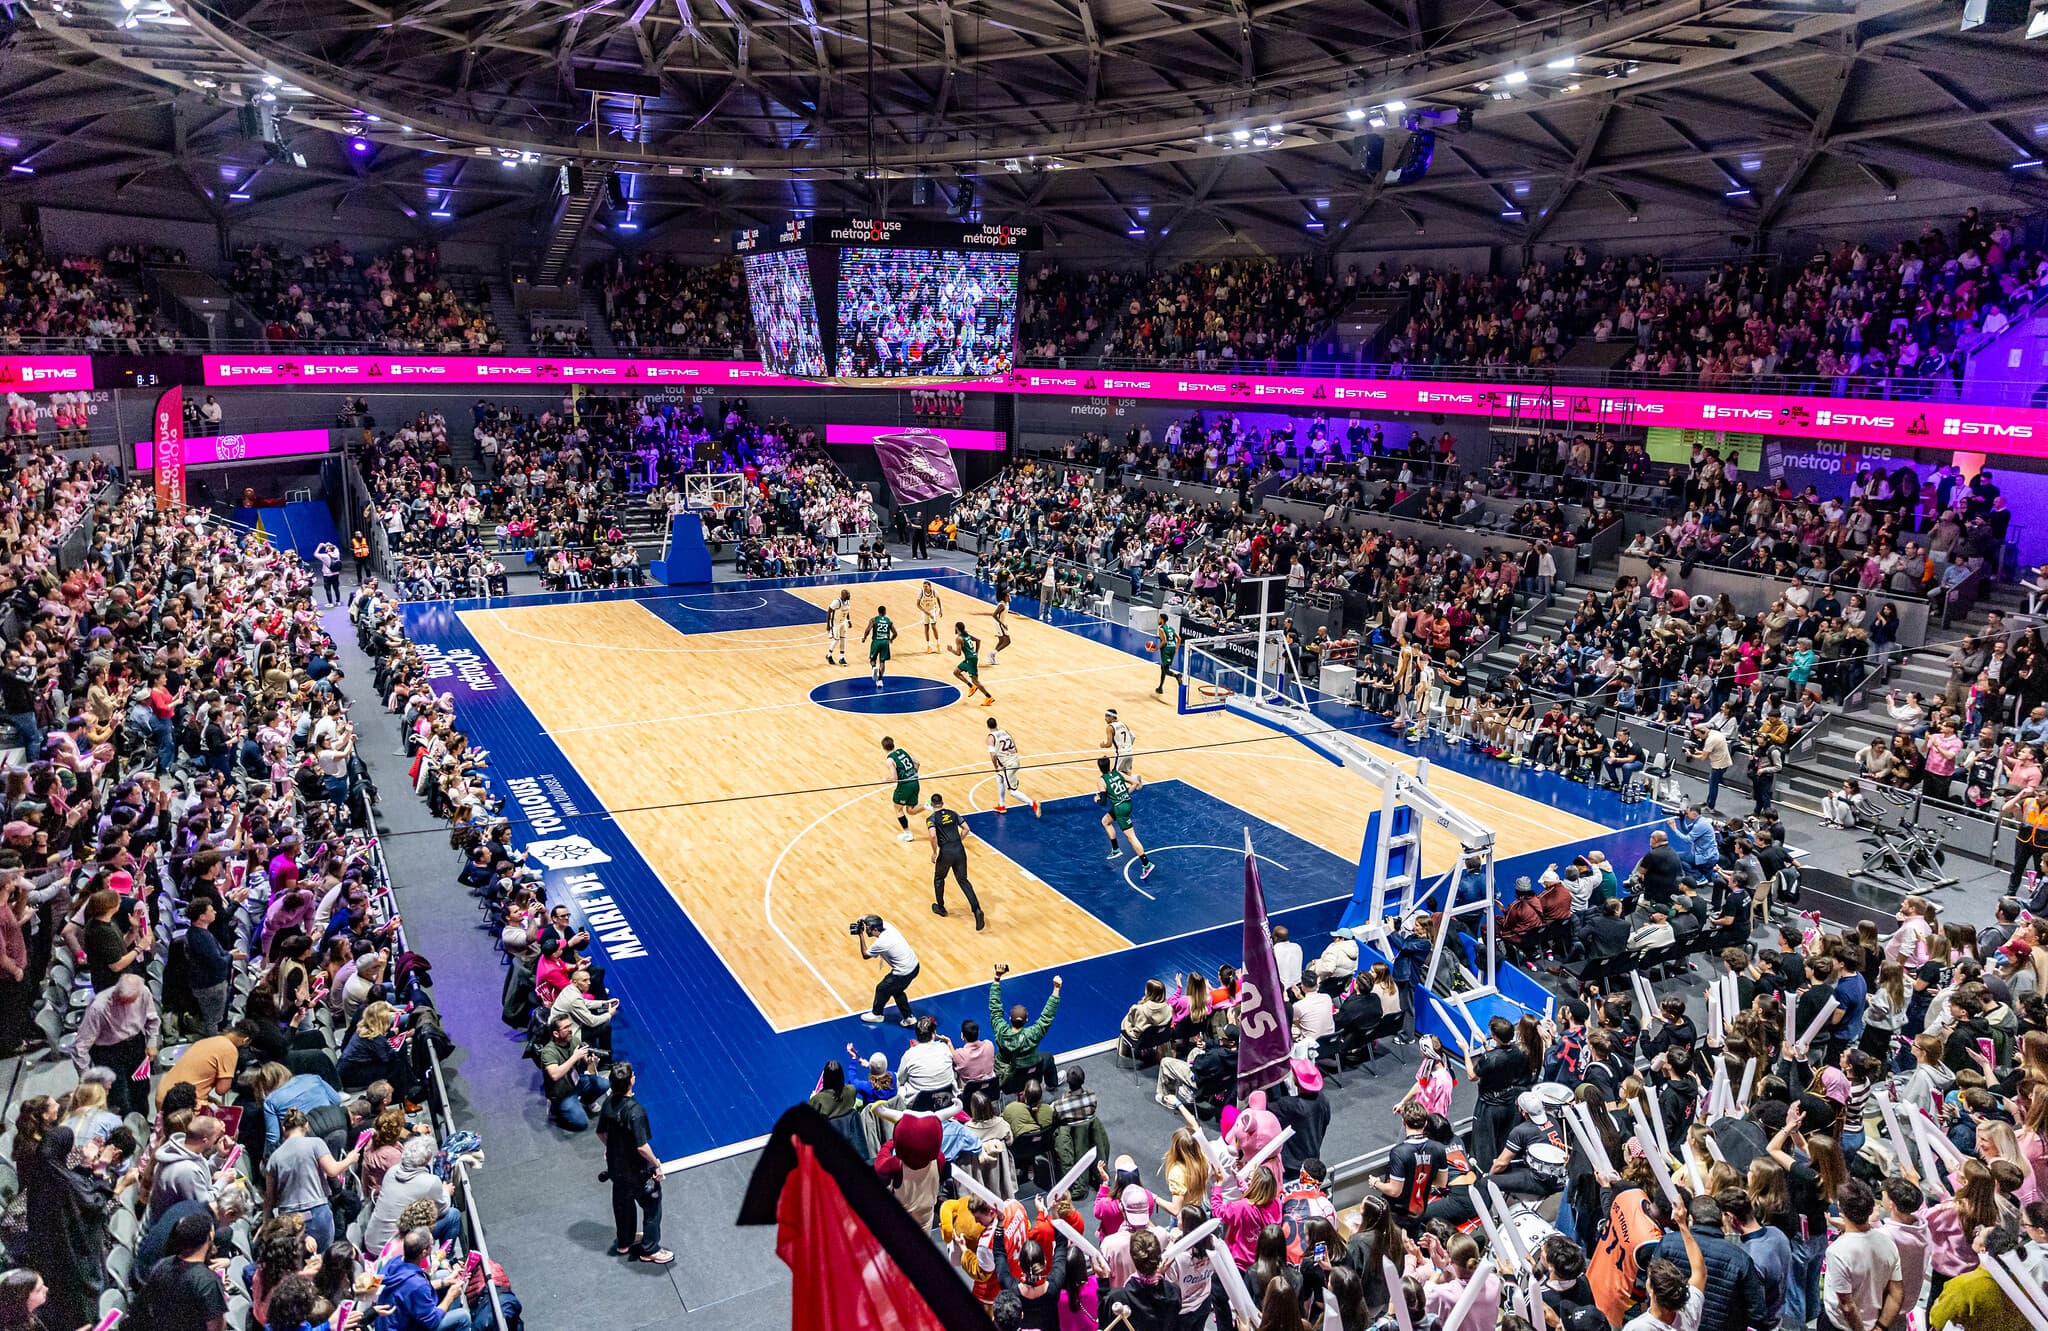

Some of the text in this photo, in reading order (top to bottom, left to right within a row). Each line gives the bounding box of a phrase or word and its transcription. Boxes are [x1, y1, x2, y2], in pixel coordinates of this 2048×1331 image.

[851, 218, 902, 231] toulouse
[983, 224, 1028, 236] toulouse
[831, 228, 891, 242] métropole
[963, 233, 1017, 246] métropole
[33, 368, 77, 378] STMS
[231, 366, 273, 375] STMS
[314, 366, 359, 375] STMS
[402, 366, 446, 375] STMS
[489, 367, 532, 375] STMS
[573, 367, 617, 376] STMS
[658, 369, 700, 377] STMS
[1040, 378, 1077, 386] STMS
[1113, 380, 1151, 389] STMS
[1187, 383, 1226, 392] STMS
[1265, 386, 1305, 395] STMS
[1345, 389, 1387, 399] STMS
[1429, 393, 1473, 403] STMS
[1519, 397, 1565, 408] STMS
[1613, 402, 1664, 414] STMS
[1717, 407, 1773, 420] STMS
[1832, 413, 1895, 428] STMS
[1961, 422, 2033, 438] STMS
[159, 412, 172, 485] toulouse
[877, 623, 888, 633] 23
[1229, 642, 1258, 659] TOULOUS
[1120, 731, 1127, 743] 7
[1000, 738, 1015, 751] 22
[902, 757, 913, 770] 13
[1111, 780, 1127, 795] 26
[506, 776, 567, 835] TOULOUSE
[563, 872, 649, 961] MAIRIE DE
[1616, 1212, 1631, 1244] THONY
